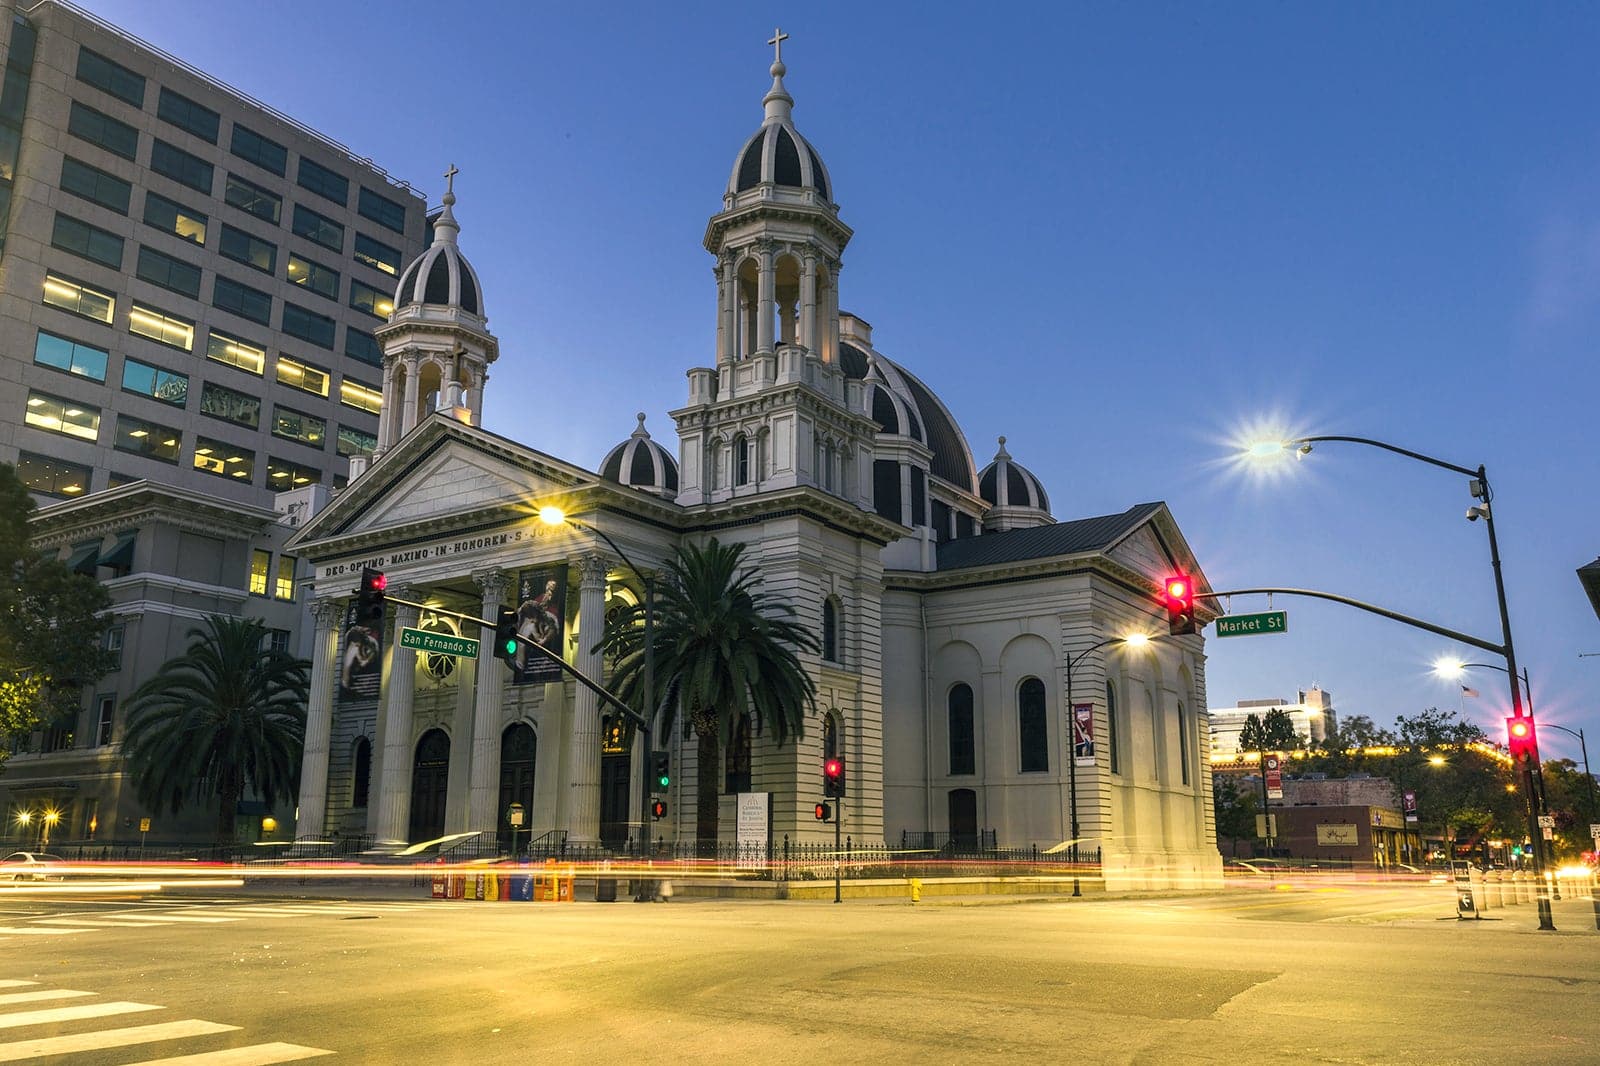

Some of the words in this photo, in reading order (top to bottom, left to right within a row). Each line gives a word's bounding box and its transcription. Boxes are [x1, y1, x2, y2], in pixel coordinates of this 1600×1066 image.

[325, 565, 345, 577] DEO
[350, 559, 385, 572] OPTIMO
[391, 549, 429, 565] MAXIMO
[435, 546, 447, 556] IN
[453, 533, 508, 553] HONOREM
[1219, 618, 1261, 632] Market
[1267, 616, 1282, 628] St
[403, 632, 421, 645] San
[423, 636, 464, 652] Fernando
[466, 643, 476, 655] St
